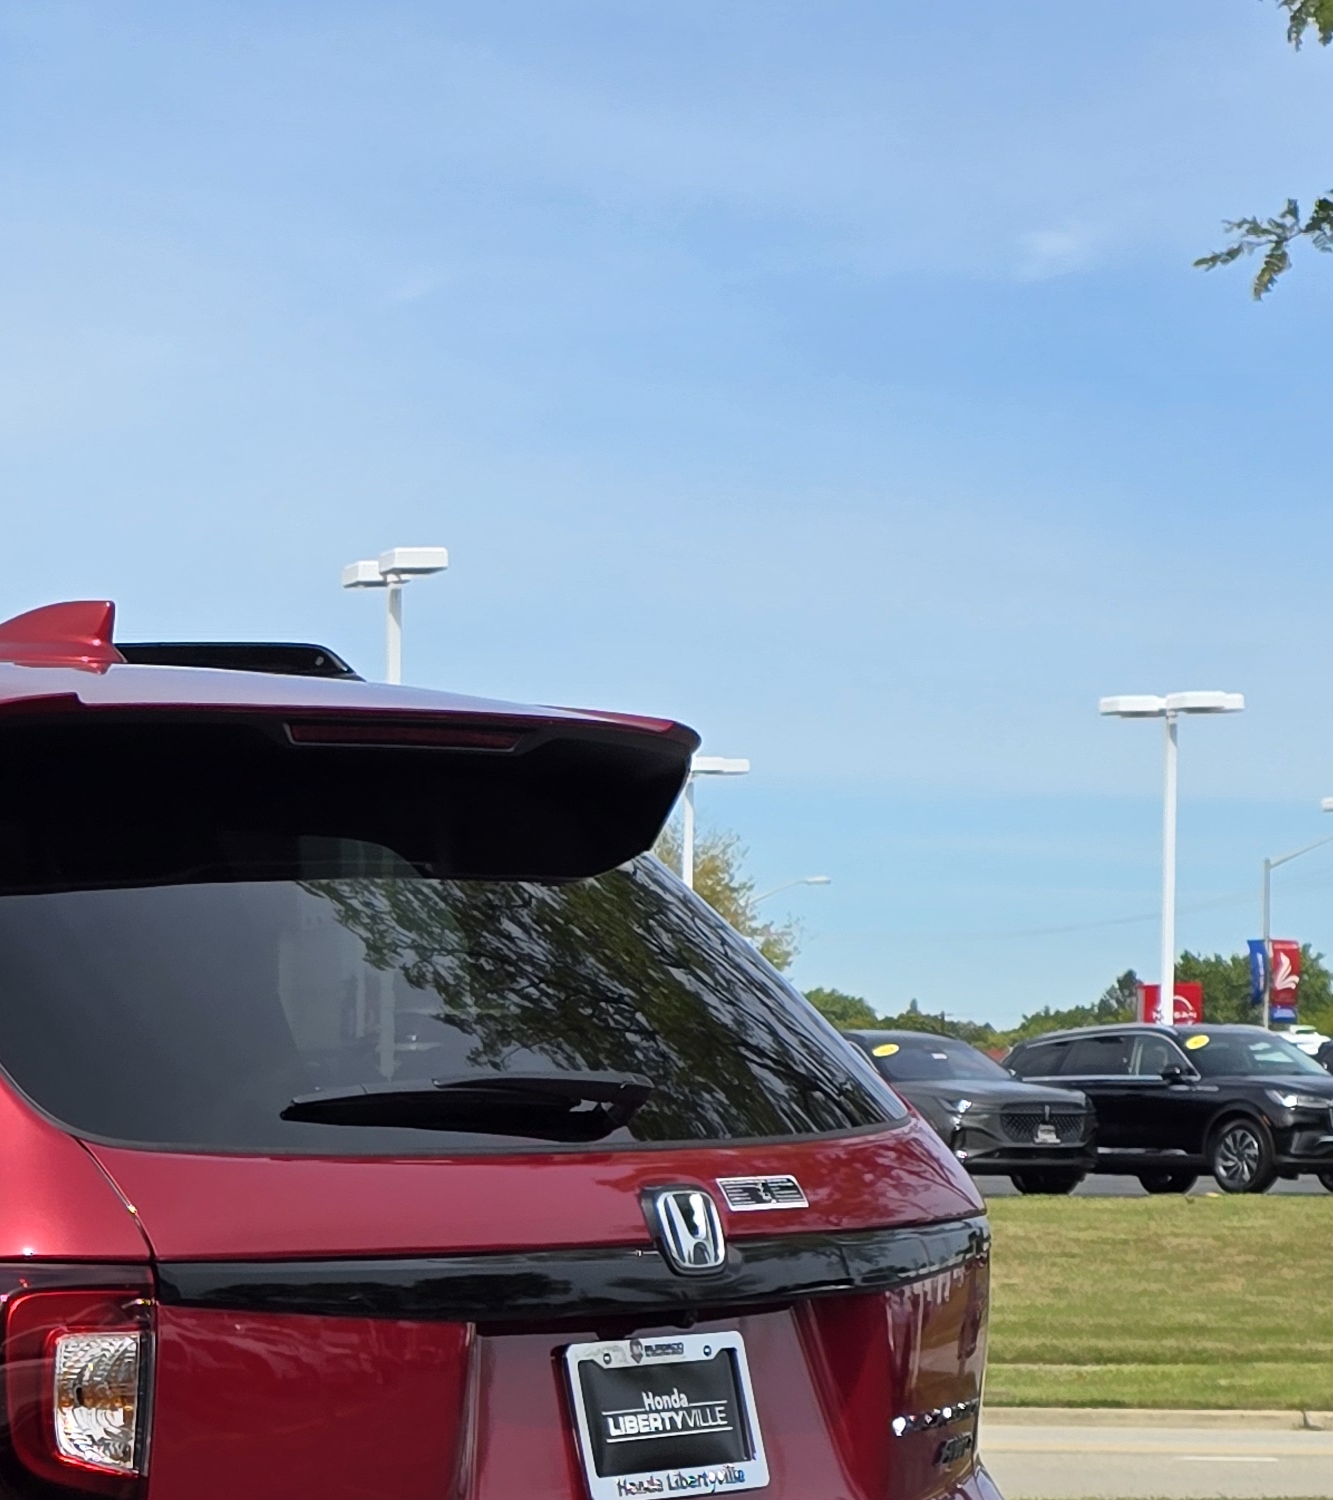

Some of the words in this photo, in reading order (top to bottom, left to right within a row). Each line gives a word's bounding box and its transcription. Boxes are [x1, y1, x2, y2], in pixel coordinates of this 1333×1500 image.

[642, 1387, 689, 1411] Honda
[608, 1406, 728, 1436] LIBERTYVILLE
[617, 1475, 664, 1497] Honda
[667, 1465, 746, 1494] Libertyville
